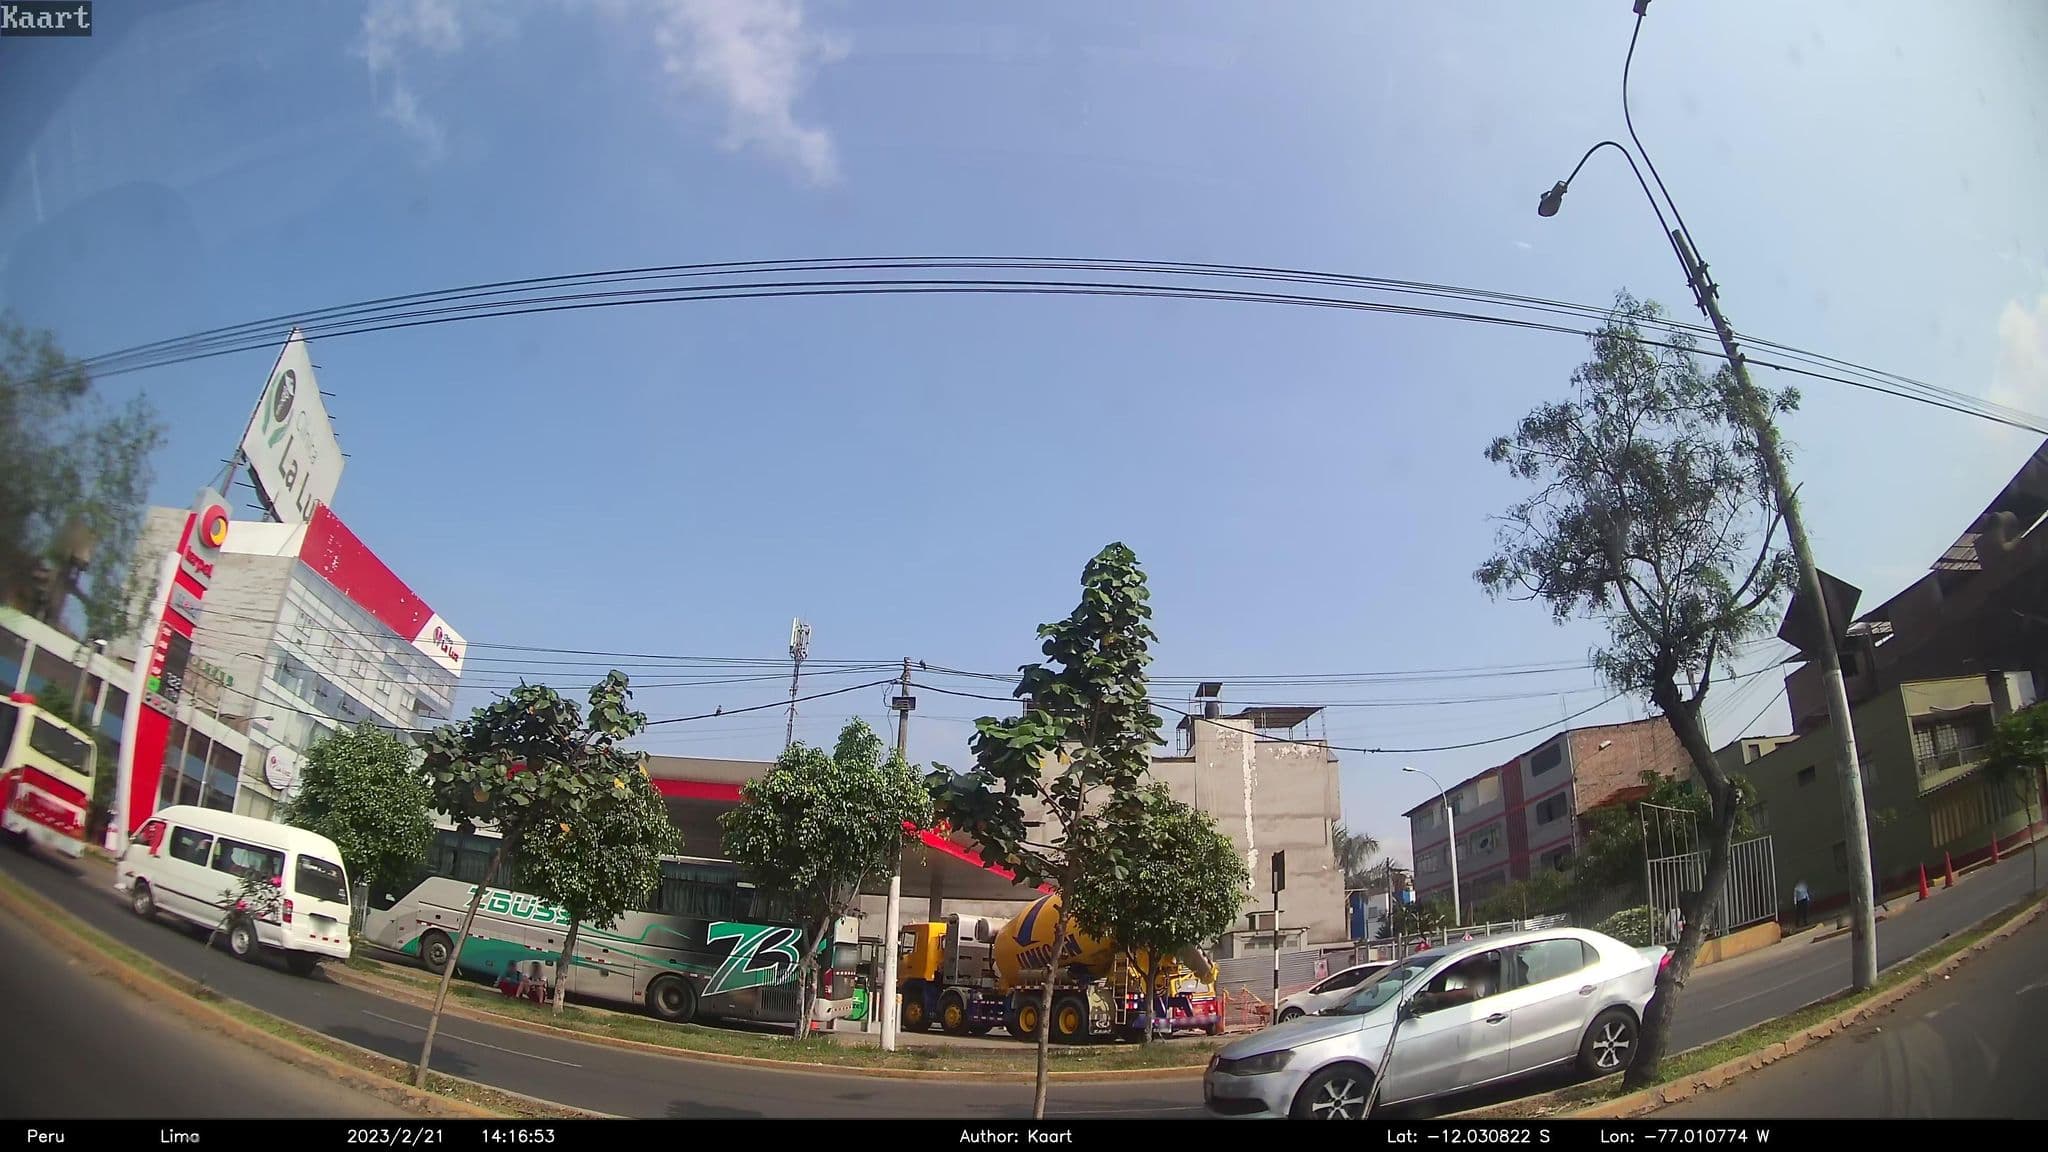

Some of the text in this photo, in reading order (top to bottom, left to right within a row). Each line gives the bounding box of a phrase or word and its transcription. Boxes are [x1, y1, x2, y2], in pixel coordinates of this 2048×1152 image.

[277, 434, 298, 492] La
[296, 471, 318, 524] Lu
[1015, 933, 1083, 969] UNICN
